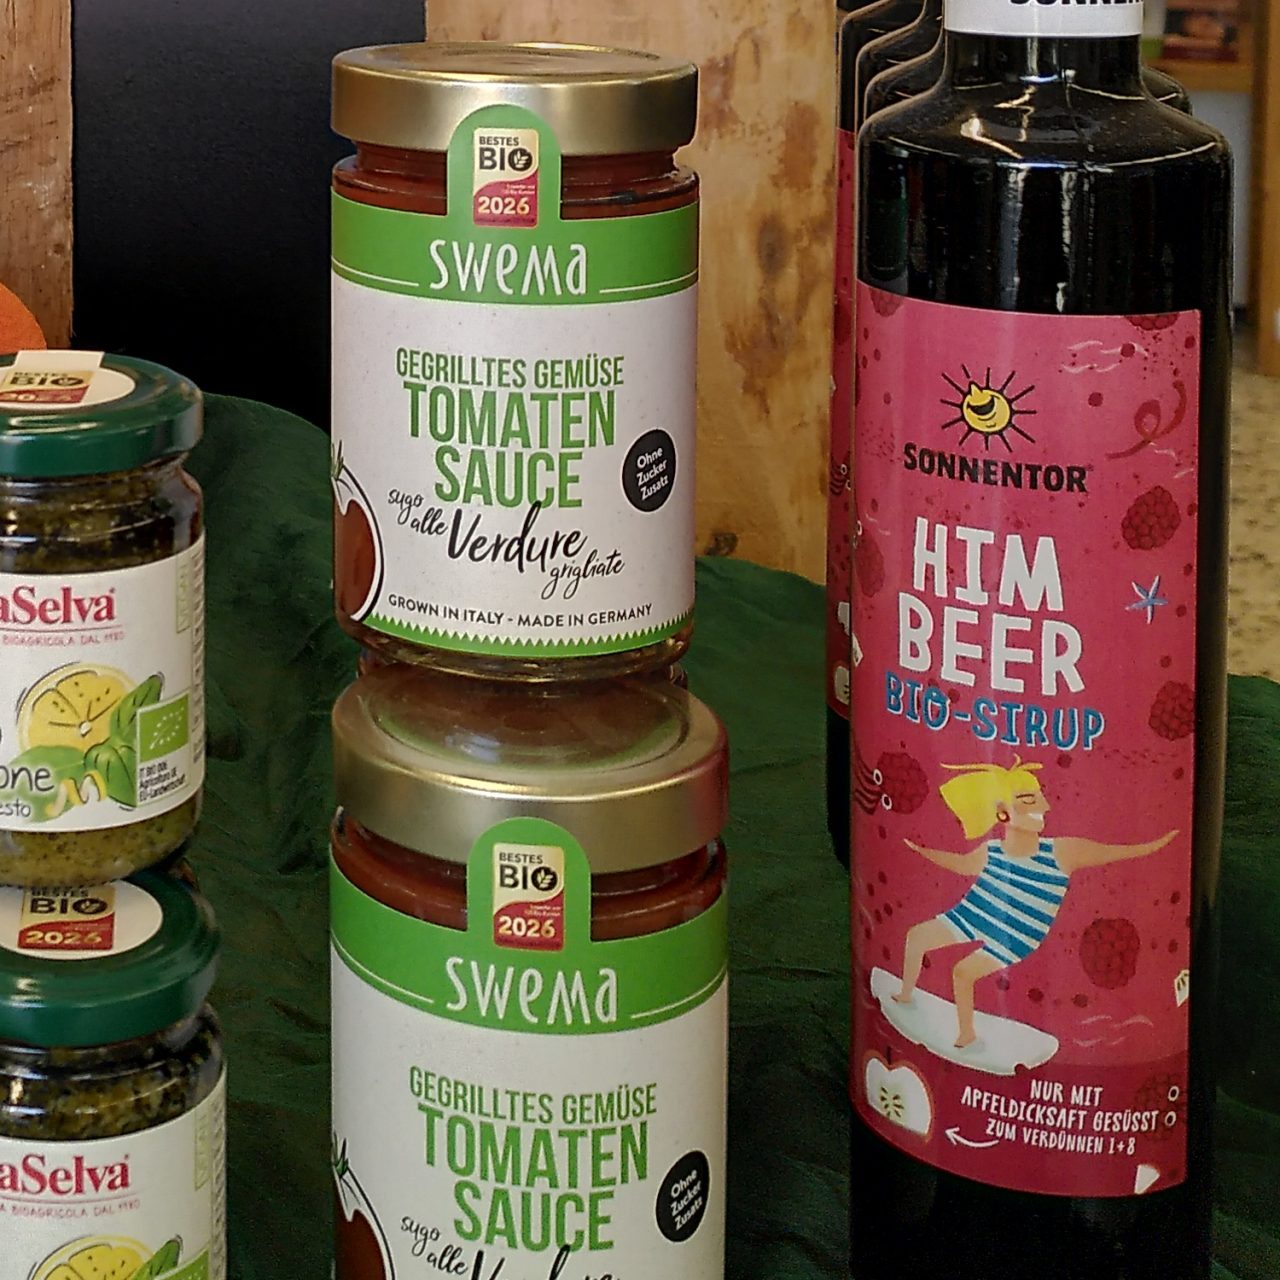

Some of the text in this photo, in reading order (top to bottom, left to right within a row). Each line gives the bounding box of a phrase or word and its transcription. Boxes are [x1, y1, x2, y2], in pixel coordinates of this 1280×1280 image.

[478, 135, 520, 146] BESTES
[478, 146, 533, 172] BIO
[477, 195, 531, 215] 2026
[395, 346, 625, 389] GEGRILLTES GEMÜSE
[402, 380, 616, 449] TOMATEN
[635, 459, 668, 487] Zucker
[636, 447, 664, 469] Ohne
[902, 442, 1089, 494] SONNENTOR
[434, 445, 584, 509] SAUCE
[639, 474, 669, 501] Zusatz
[410, 506, 449, 536] alle
[446, 500, 588, 574] Verdure
[540, 548, 626, 601] grigliate
[911, 516, 1065, 613] HIM
[387, 593, 440, 618] GROWN
[442, 605, 460, 620] IN
[463, 609, 505, 625] ITALY
[517, 613, 564, 627] MADE
[568, 613, 584, 627] IN
[587, 602, 653, 626] GERMANY
[897, 591, 1086, 697] BEER
[884, 671, 1106, 751] BIO-SIRUP
[498, 852, 544, 865] BESTES
[498, 864, 559, 891] BIO
[29, 897, 108, 915] BIO
[498, 915, 557, 939] 2026
[409, 1064, 658, 1126] GEGRILLTES GEMÜSE
[960, 1085, 1160, 1132] APFELDICKSAFT GESÜSST
[1029, 1078, 1104, 1107] NUR MIT
[416, 1102, 650, 1190] TOMATEN
[985, 1117, 1017, 1142] ZUM
[1022, 1126, 1105, 1155] VERDÜNNEN
[670, 1168, 698, 1199] Ohne
[670, 1180, 702, 1217] Zucker
[452, 1179, 617, 1253] SAUCE
[674, 1195, 703, 1231] Zusatz
[426, 1244, 469, 1276] alle
